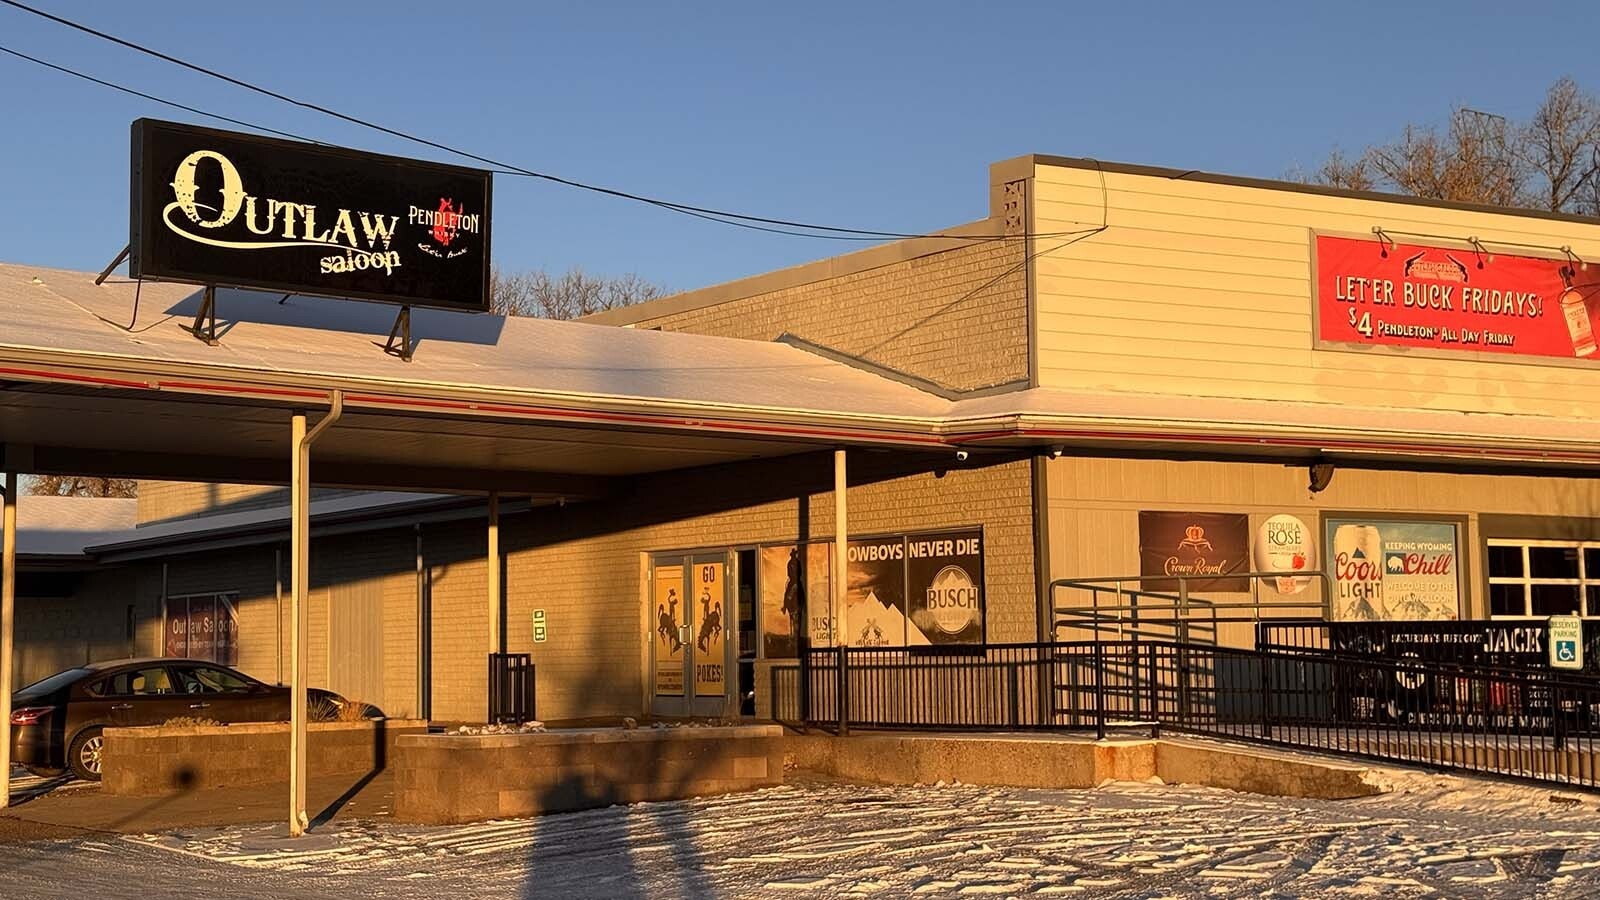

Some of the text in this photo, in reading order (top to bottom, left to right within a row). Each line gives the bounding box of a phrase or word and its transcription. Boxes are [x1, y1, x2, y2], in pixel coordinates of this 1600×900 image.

[165, 150, 399, 248] OUTLAW
[408, 205, 480, 234] PENDLETON
[320, 249, 401, 276] saloon
[1336, 275, 1543, 317] LET'ER BUCK FRIDAYS!
[1348, 306, 1373, 338] $4
[1441, 326, 1458, 342] ALL
[1461, 327, 1480, 343] DAY
[1483, 329, 1515, 346] FRIDAY
[1267, 522, 1300, 532] TEQUILA
[1268, 530, 1302, 546] ROSE
[848, 538, 980, 562] OWBOYS NEVER DIE
[1385, 542, 1453, 551] KEEPING WYOMING
[702, 566, 715, 583] GO
[1164, 556, 1227, 576] Crown Royal
[1404, 552, 1453, 576] Chill
[928, 588, 977, 610] BUSCH
[1340, 582, 1381, 598] LIGHT
